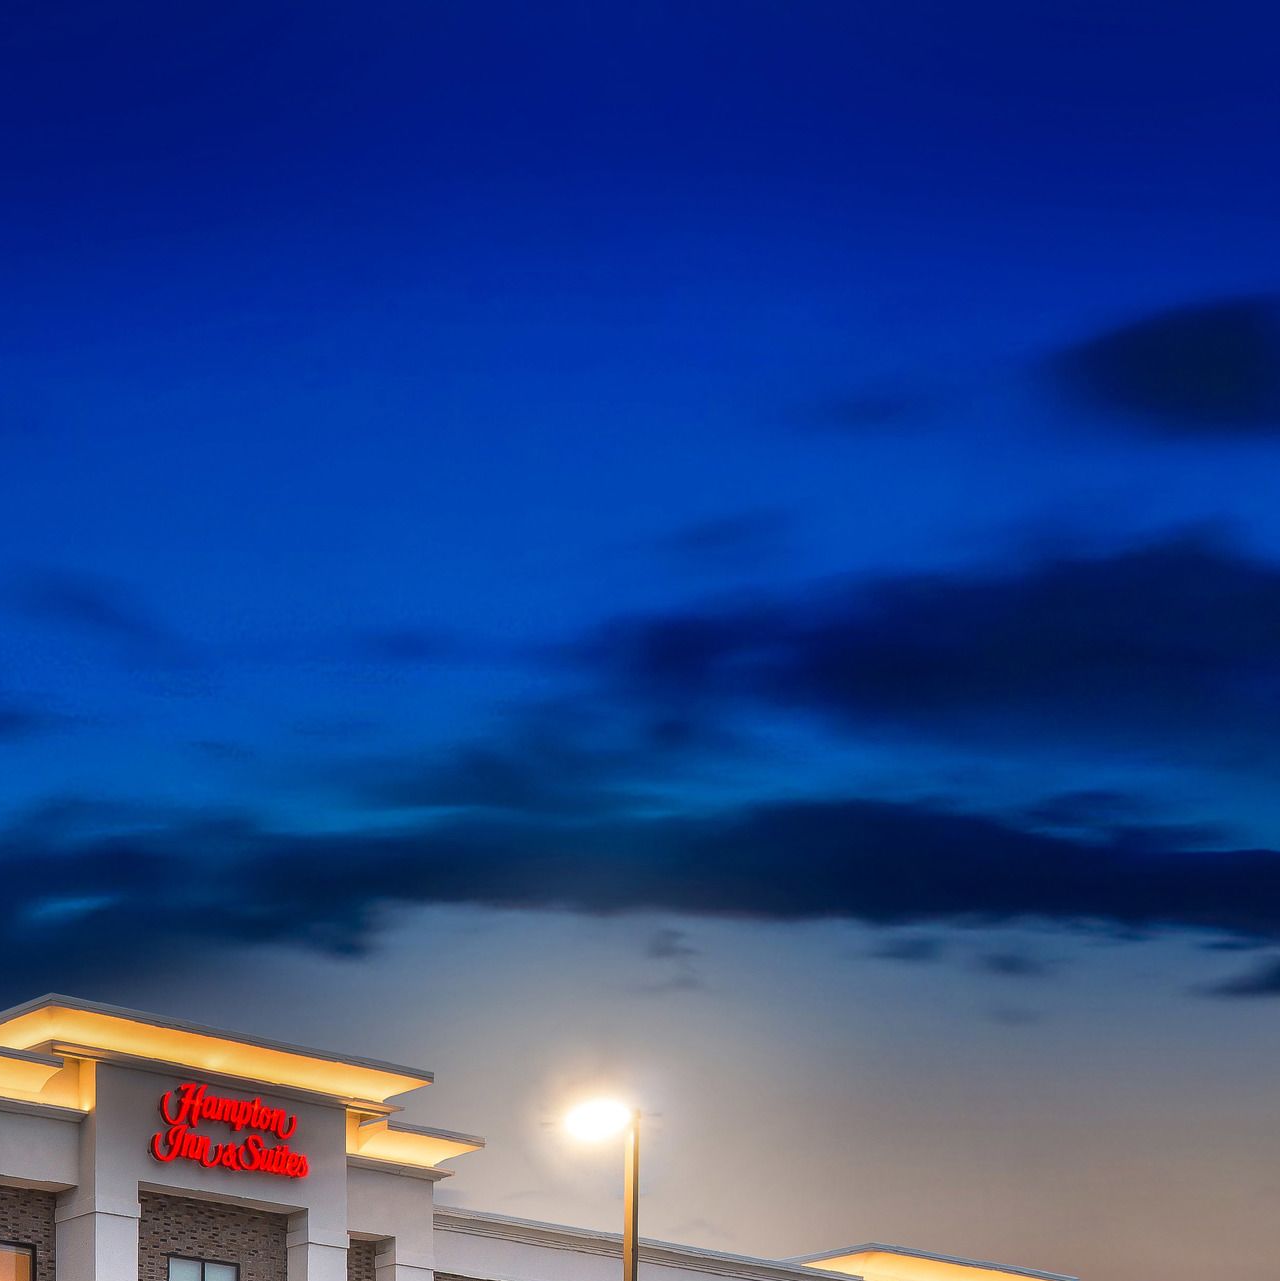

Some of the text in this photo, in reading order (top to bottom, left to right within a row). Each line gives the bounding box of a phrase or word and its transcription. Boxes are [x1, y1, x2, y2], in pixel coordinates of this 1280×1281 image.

[160, 1083, 297, 1140] Hampton
[151, 1124, 309, 1178] Inn & Suites
